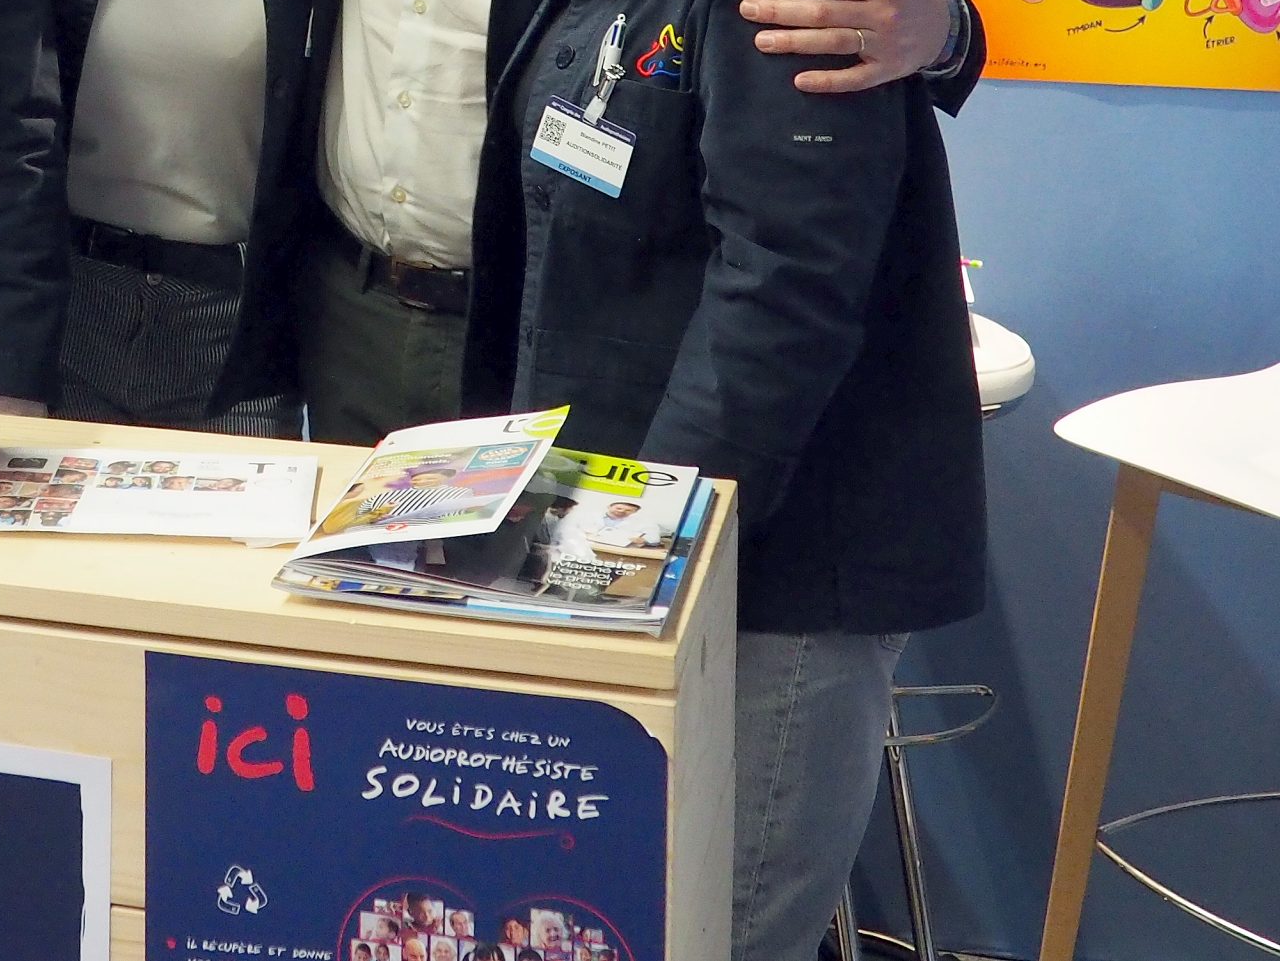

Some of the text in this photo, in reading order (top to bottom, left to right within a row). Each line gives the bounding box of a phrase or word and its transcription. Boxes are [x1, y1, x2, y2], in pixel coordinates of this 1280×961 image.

[1205, 35, 1235, 49] ÉTRIER
[558, 163, 592, 183] EXPOSANT
[615, 569, 636, 577] de
[196, 694, 571, 792] ici VOUS ÊTES CHEZ UN
[202, 939, 263, 955] RÉCUPÈRE
[268, 947, 287, 957] ET
[292, 949, 333, 961] DONNE
